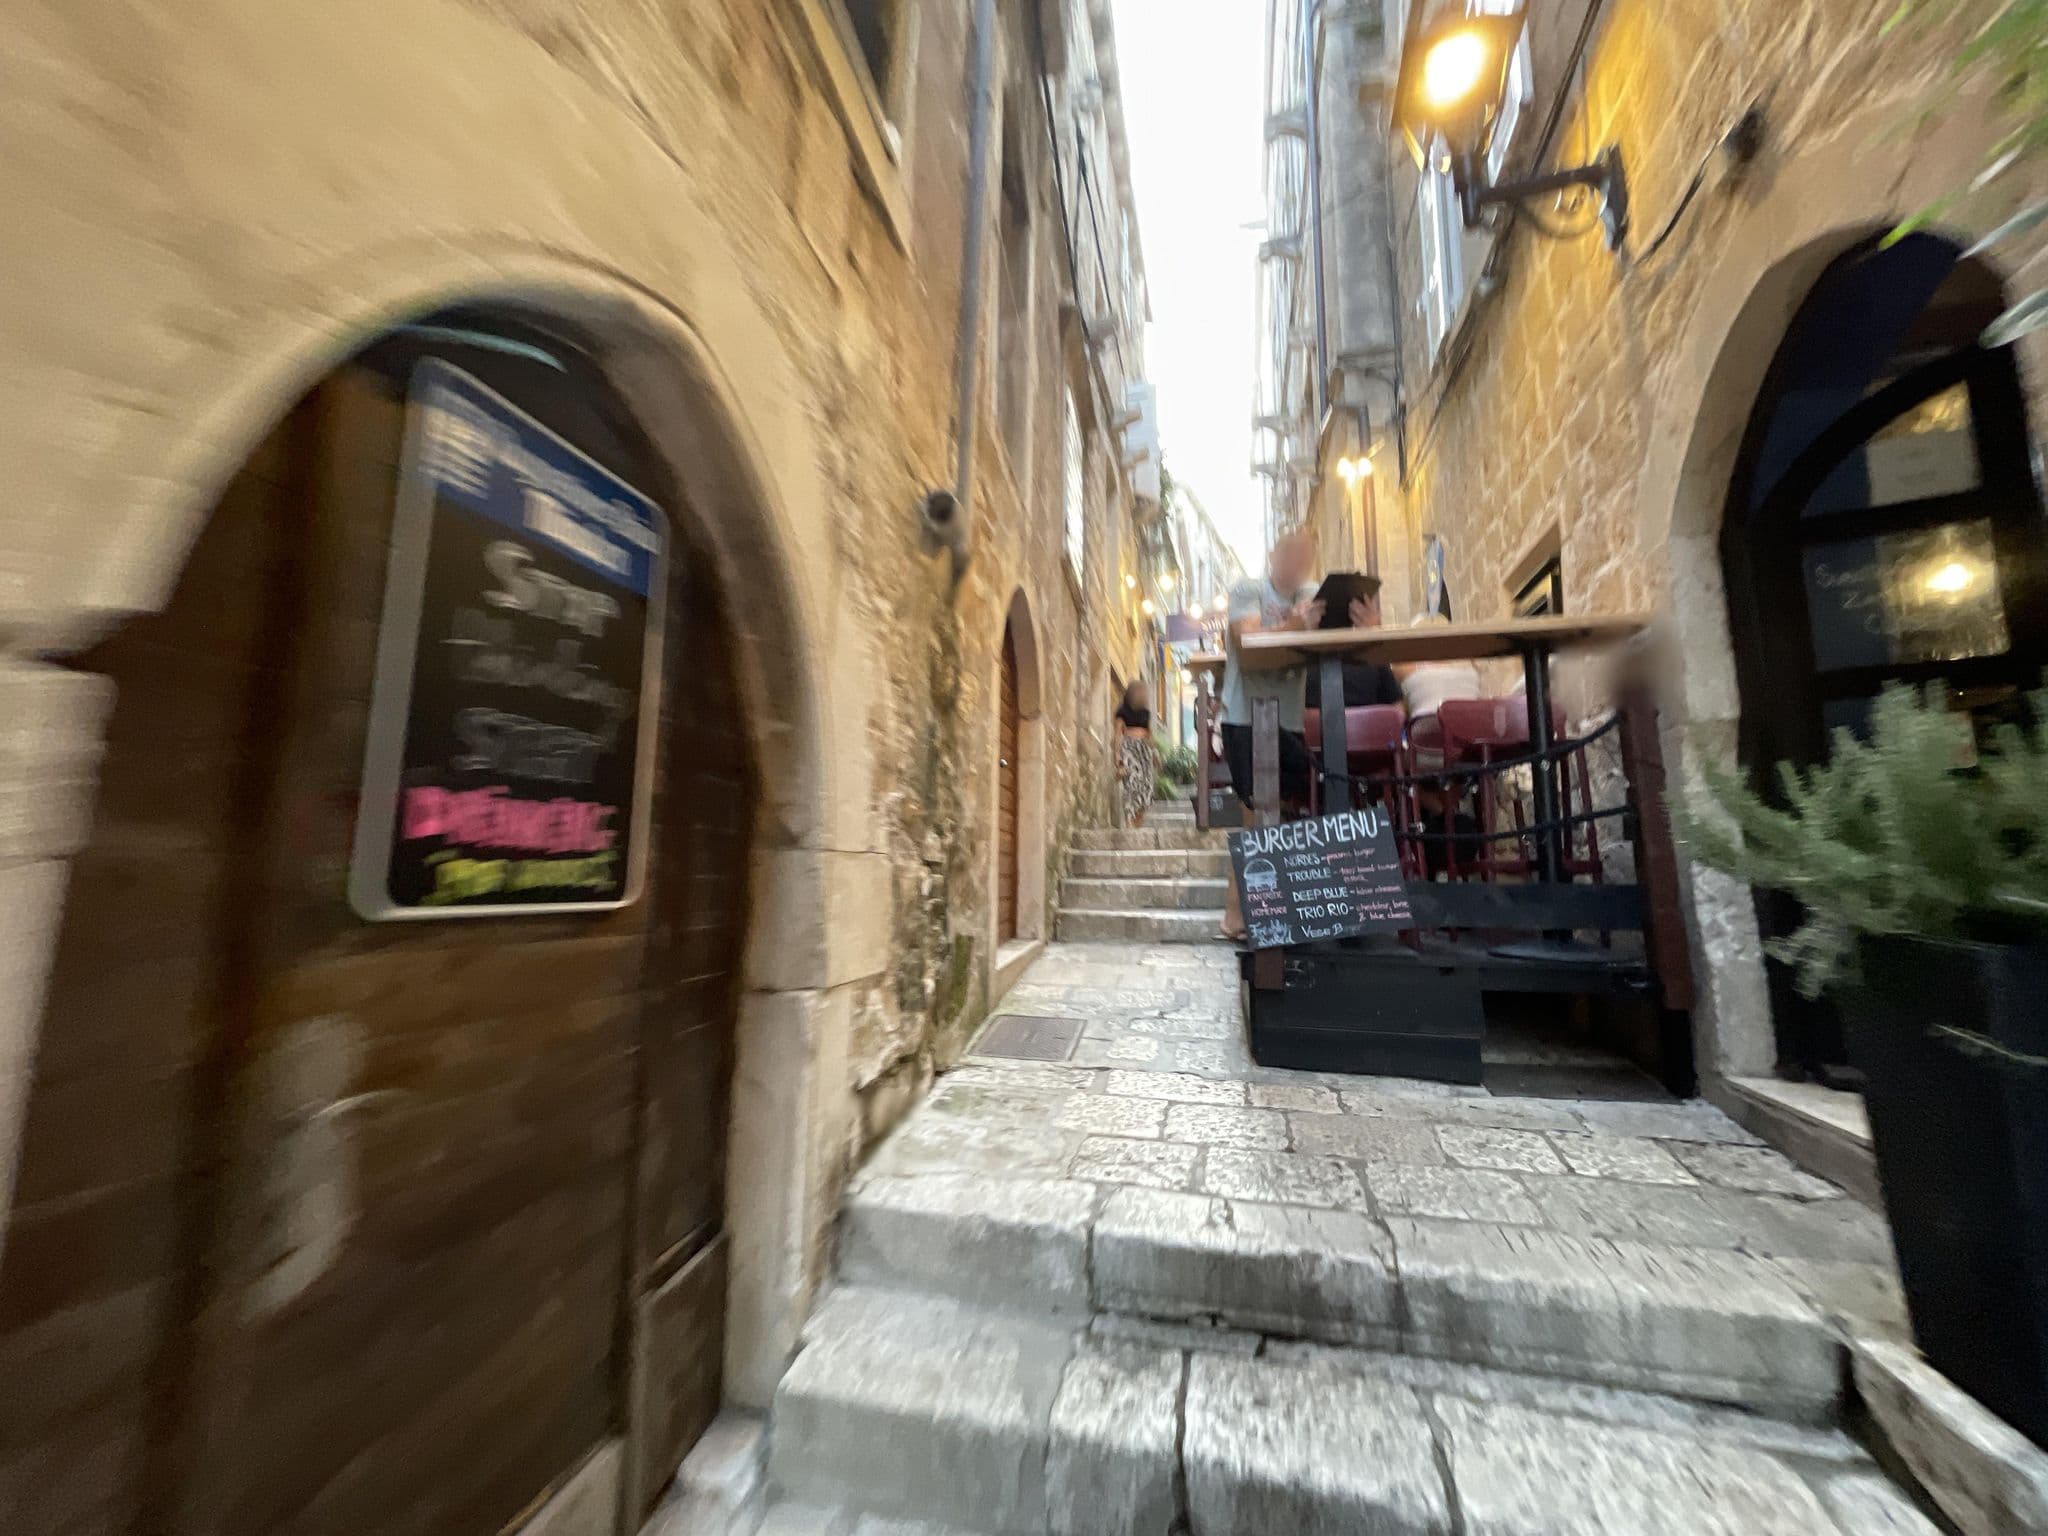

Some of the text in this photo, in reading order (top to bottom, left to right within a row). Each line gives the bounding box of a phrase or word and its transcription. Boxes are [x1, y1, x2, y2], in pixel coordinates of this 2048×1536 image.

[1241, 810, 1378, 857] BURGER MENU
[1287, 867, 1331, 882] TROUBLE
[1292, 888, 1322, 902] DEEP
[1323, 887, 1349, 899] BLUE
[1296, 905, 1325, 920] TRIO
[1327, 902, 1349, 917] RIO
